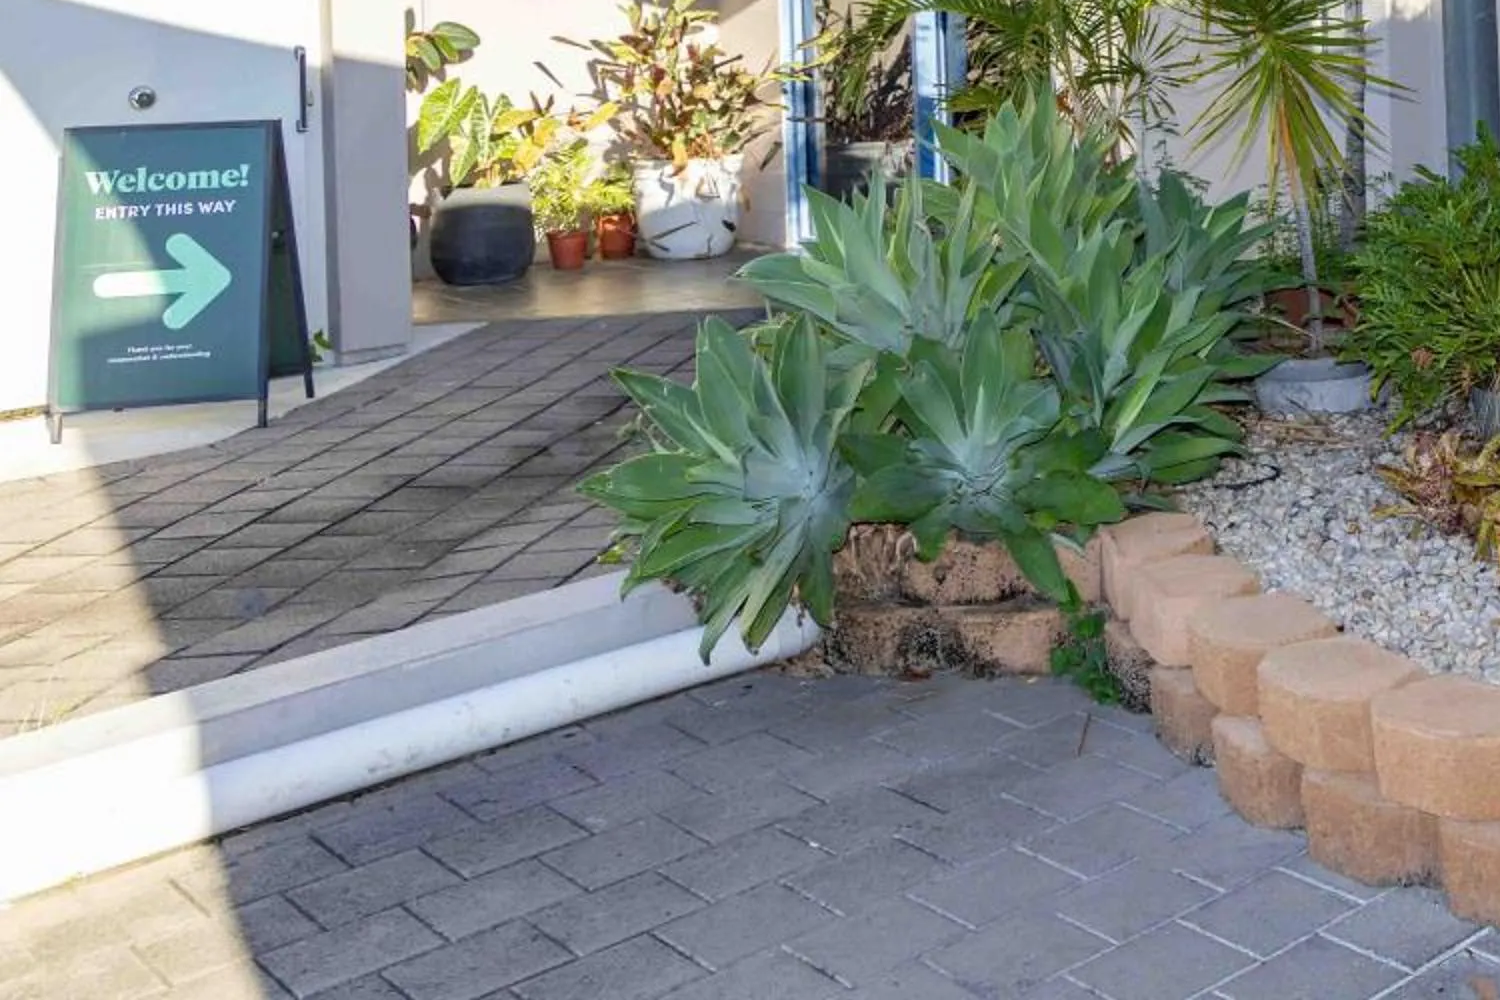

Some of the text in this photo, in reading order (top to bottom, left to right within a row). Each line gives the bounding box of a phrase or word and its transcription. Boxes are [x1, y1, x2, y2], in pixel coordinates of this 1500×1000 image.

[84, 164, 250, 195] Welcome!
[95, 200, 236, 219] ENTRY THIS WAY
